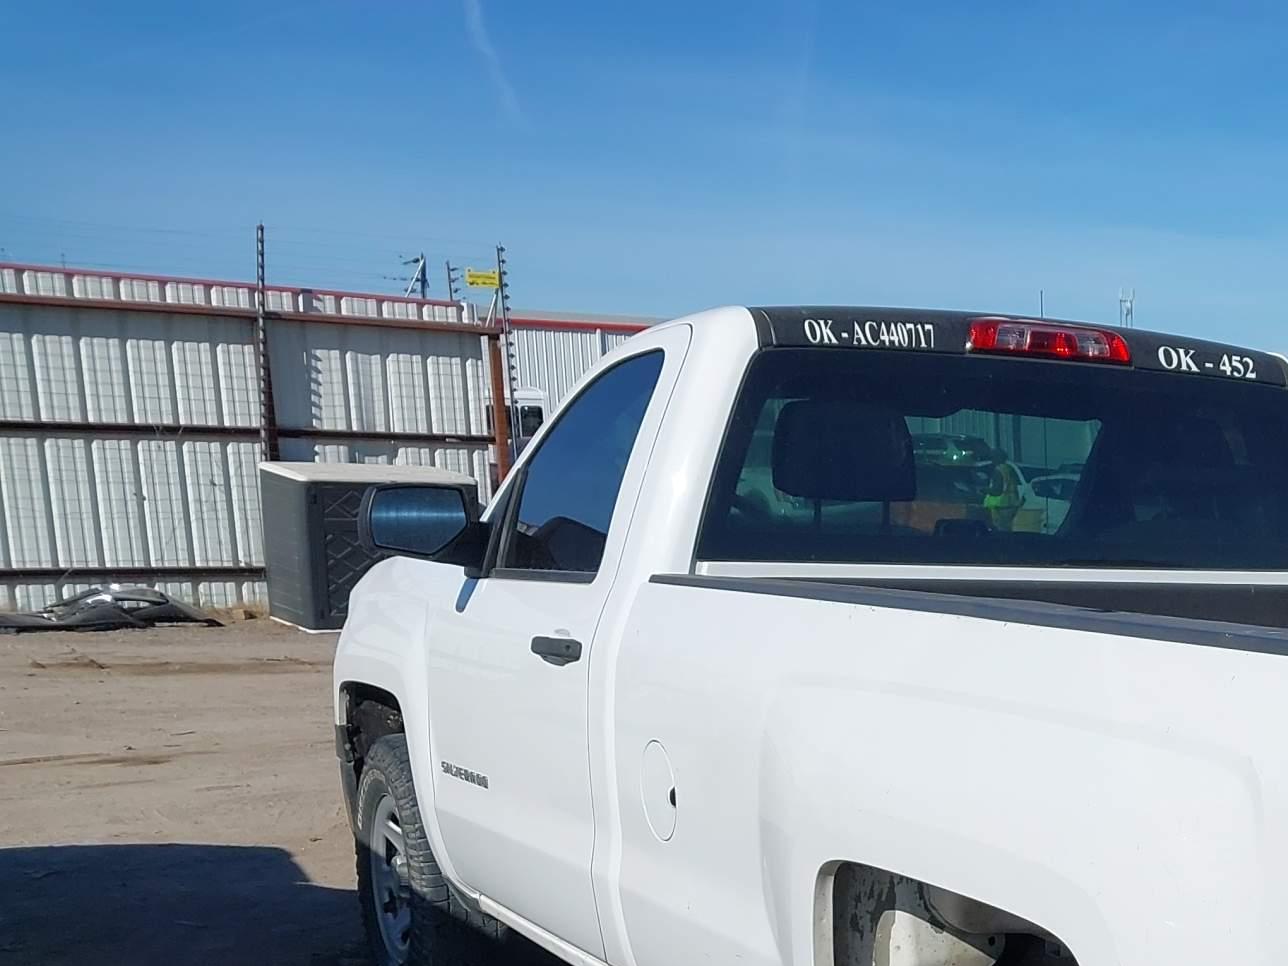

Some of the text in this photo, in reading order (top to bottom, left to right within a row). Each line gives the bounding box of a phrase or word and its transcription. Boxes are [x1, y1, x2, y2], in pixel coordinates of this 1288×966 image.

[803, 318, 839, 345] OK
[1157, 345, 1201, 373] OK
[1219, 353, 1257, 379] 452
